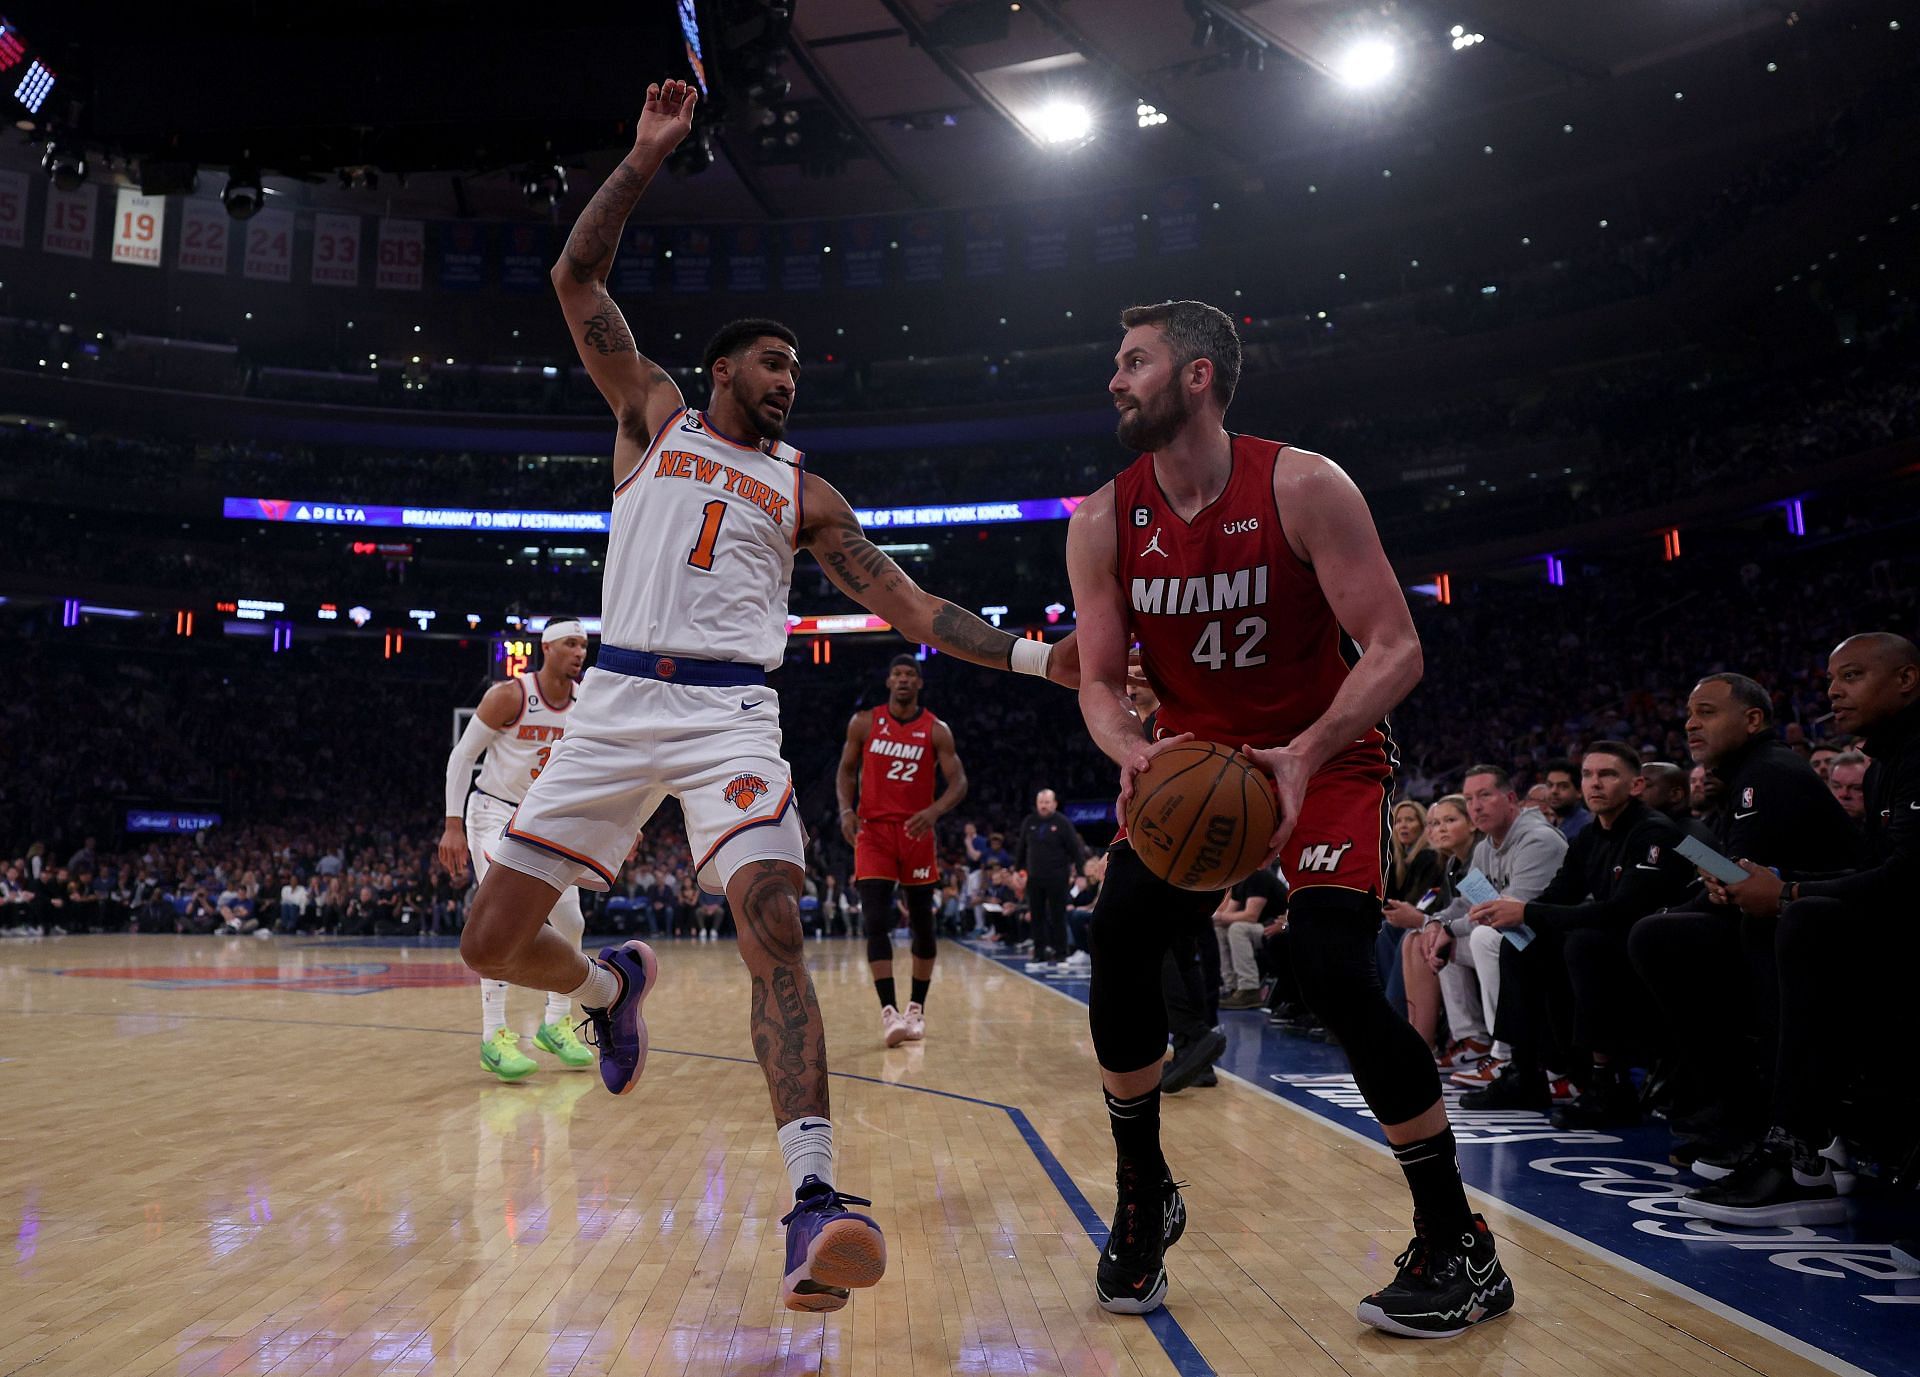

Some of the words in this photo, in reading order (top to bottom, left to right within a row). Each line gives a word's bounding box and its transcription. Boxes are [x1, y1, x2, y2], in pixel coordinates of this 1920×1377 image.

[54, 200, 88, 233] 15
[122, 211, 156, 241] 19
[184, 220, 225, 250] 22
[249, 228, 289, 258] 24
[318, 233, 356, 263] 33
[114, 244, 159, 261] KNICKS
[379, 237, 422, 268] 613
[654, 450, 723, 485] NEW
[723, 465, 790, 526] YORK
[313, 506, 366, 521] DELTA
[403, 510, 473, 526] BREAKAWAY
[475, 512, 492, 527] TO
[493, 512, 520, 528] NEW
[875, 510, 890, 526] OF
[893, 509, 914, 525] THE
[916, 508, 943, 523] NEW
[943, 507, 977, 522] YORK
[1135, 508, 1148, 526] 6
[1223, 517, 1259, 535] UKG
[687, 499, 728, 572] 1
[1131, 565, 1268, 615] MIAMI
[1191, 616, 1267, 670] 42
[506, 655, 528, 679] 12
[517, 725, 550, 742] NEW
[869, 738, 924, 760] MIAMI
[886, 760, 918, 782] 22
[724, 775, 769, 804] KNICKS
[1529, 1156, 1904, 1280] Google
